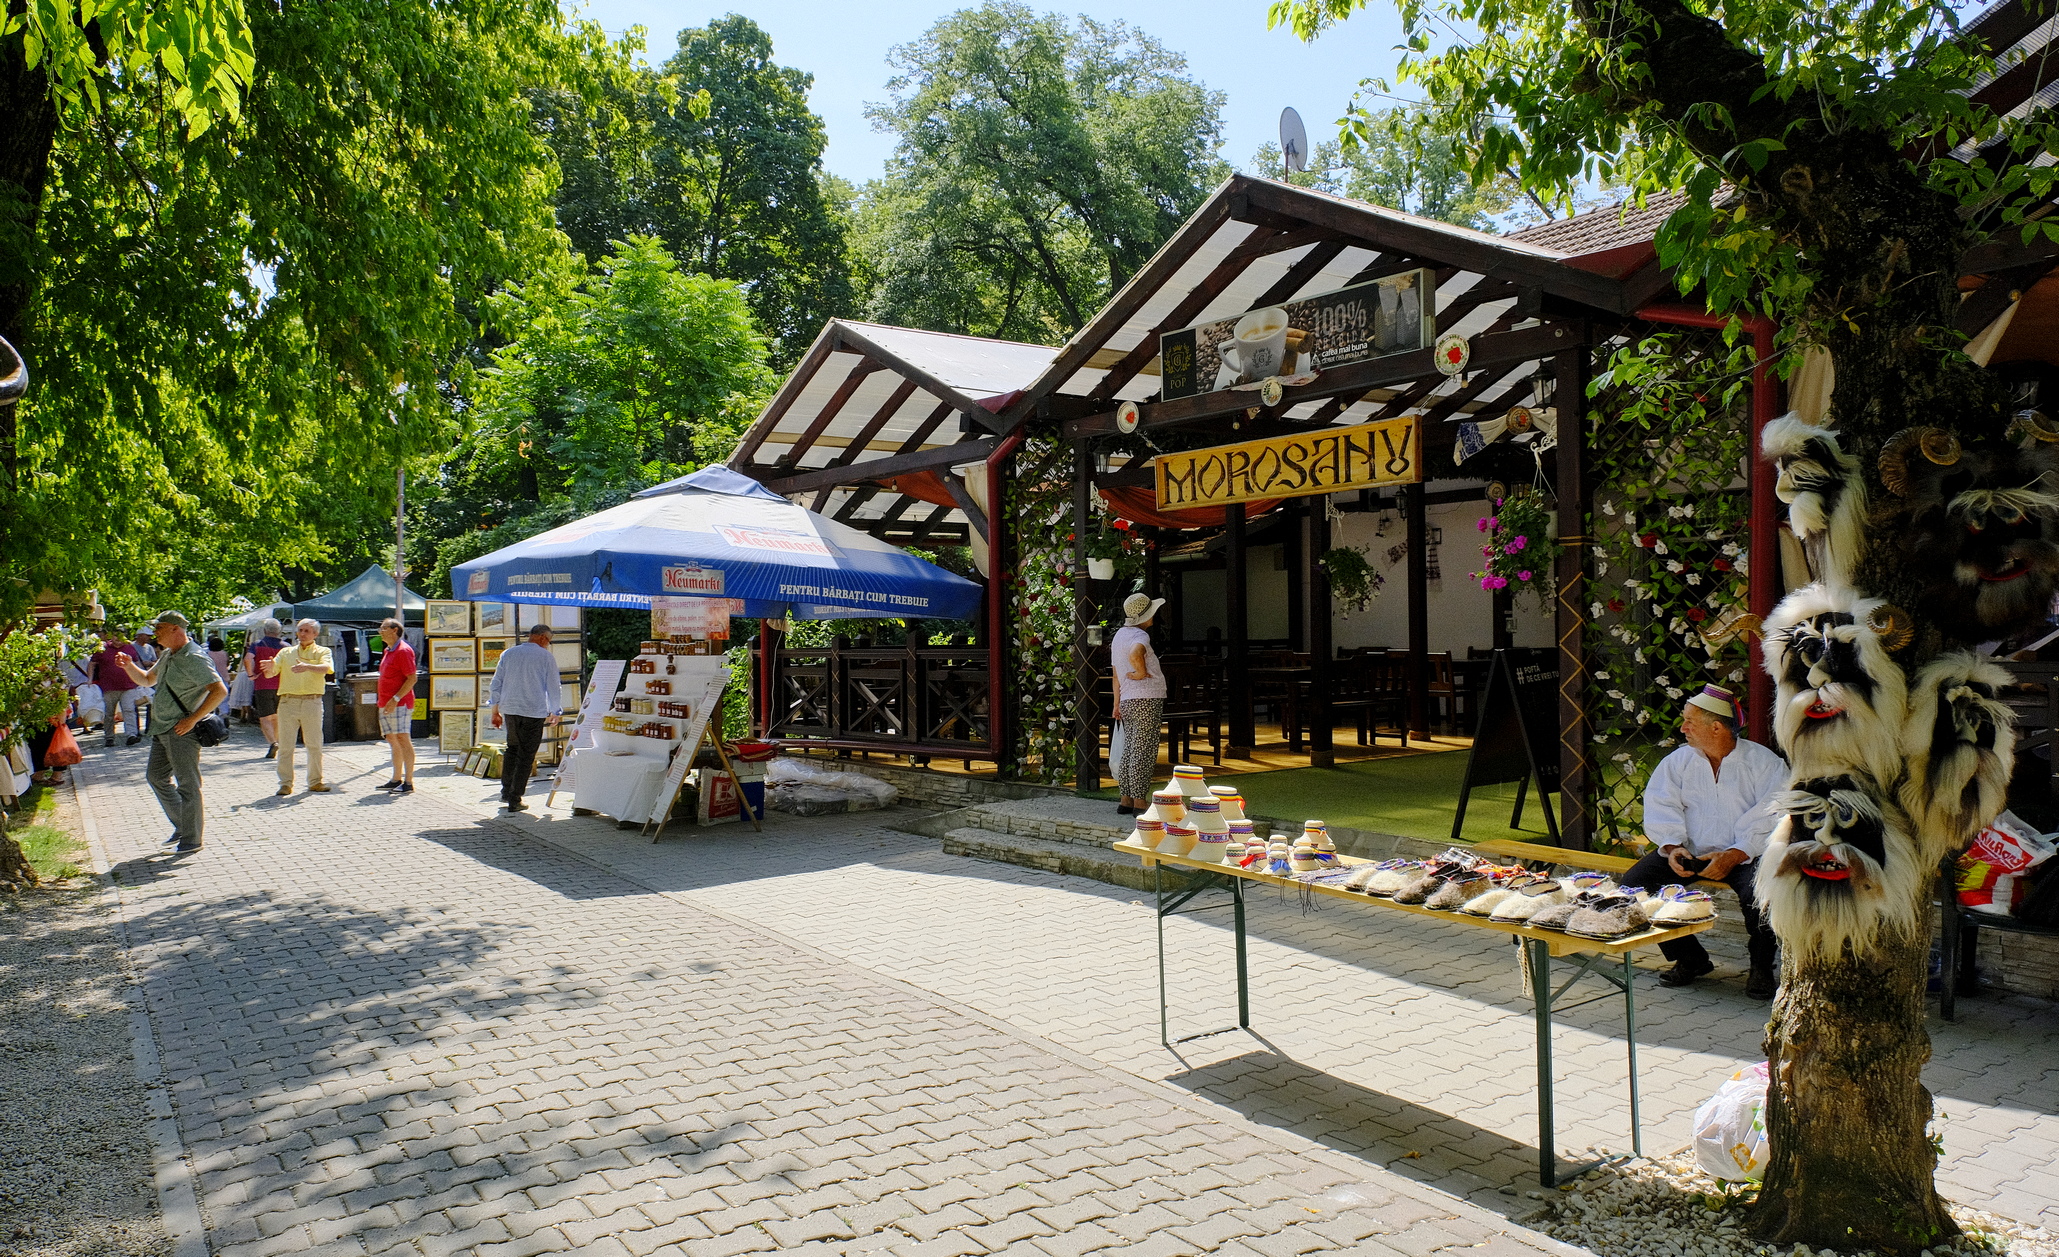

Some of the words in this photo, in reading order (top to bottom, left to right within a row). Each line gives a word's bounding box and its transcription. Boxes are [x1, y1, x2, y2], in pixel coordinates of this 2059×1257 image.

[1313, 299, 1367, 338] 100%
[1321, 348, 1338, 358] cafea
[1170, 377, 1187, 389] POP
[723, 528, 836, 554] Neumarkt
[665, 569, 721, 590] Neumarkt
[779, 584, 820, 597] PENTRU
[866, 591, 887, 603] CUM
[889, 594, 929, 608] TREBUIE
[1526, 674, 1534, 683] DE
[1533, 673, 1541, 682] CE
